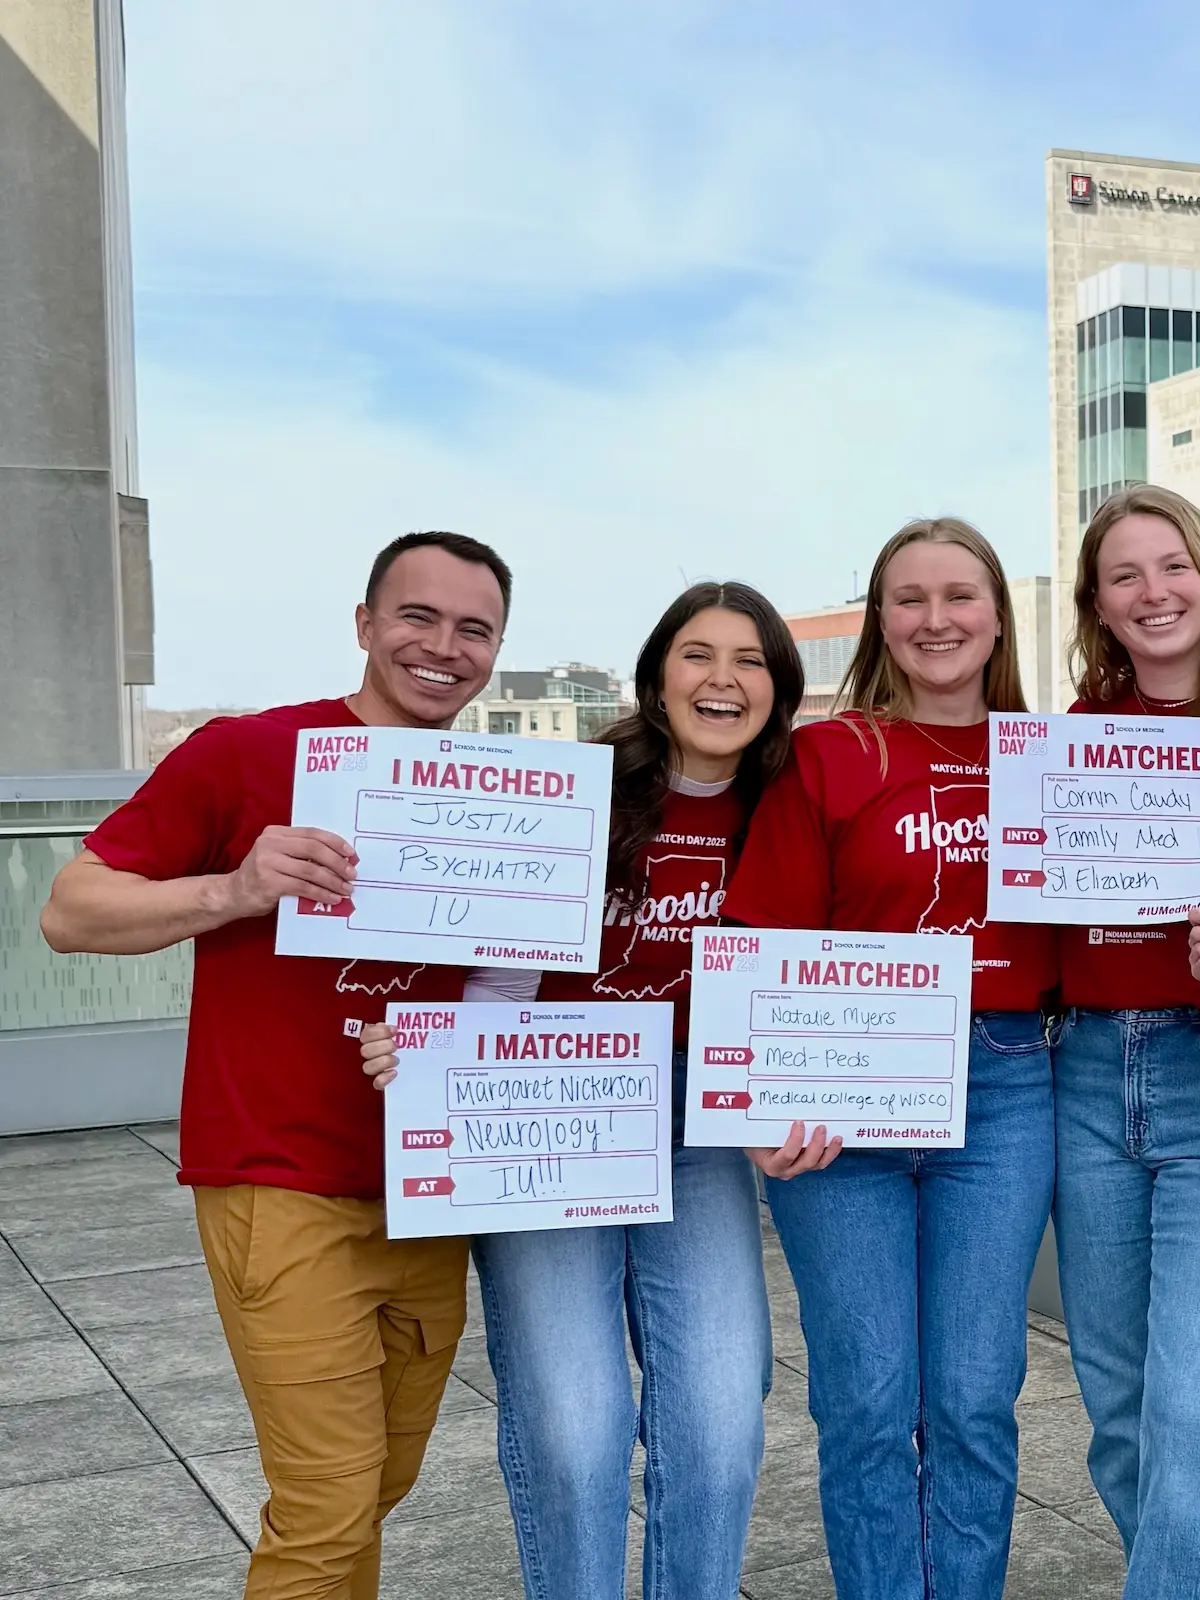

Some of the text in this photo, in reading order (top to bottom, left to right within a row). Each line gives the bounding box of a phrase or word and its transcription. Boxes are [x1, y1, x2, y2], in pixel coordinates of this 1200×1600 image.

[1099, 181, 1150, 202] Simon
[999, 721, 1047, 738] MATCH
[308, 736, 368, 754] MATCH
[999, 739, 1047, 755] DAY 25
[306, 754, 368, 772] DAY 25
[1068, 744, 1074, 767] I
[930, 764, 963, 774] MATCH
[965, 765, 983, 775] DAY
[392, 759, 574, 799] I MATCHED!
[411, 802, 542, 834] JUSTIN
[686, 836, 705, 845] DAY
[706, 837, 726, 846] 2025
[895, 812, 988, 853] Hoos
[1007, 832, 1039, 841] INTO
[1056, 824, 1178, 853] Family Med
[400, 846, 556, 882] PSYCHIATRY
[946, 848, 988, 862] MATC
[1014, 874, 1030, 883] AT
[1076, 867, 1159, 891] Elizabeth
[603, 881, 727, 926] Hoosie
[642, 927, 693, 942] MATC
[703, 936, 759, 954] MATCH
[474, 946, 583, 963] #IUMedMatch
[703, 954, 759, 972] DAY 25
[781, 960, 939, 988] I MATCHED!
[397, 1012, 455, 1029] MATCH
[772, 1006, 896, 1033] Natalie Myers
[396, 1031, 454, 1049] DAY 25
[478, 1033, 640, 1060] I MATCHED!
[709, 1052, 745, 1061] INTO
[456, 1074, 652, 1110] Margaret Nickerson
[716, 1095, 735, 1105] AT
[759, 1091, 816, 1105] Medical
[822, 1092, 874, 1110] college
[880, 1093, 896, 1115] of
[407, 1134, 444, 1145] INTO
[856, 1129, 951, 1139] #IUMedMatch
[418, 1181, 437, 1192] AT
[565, 1203, 659, 1217] #IUMedMatch
